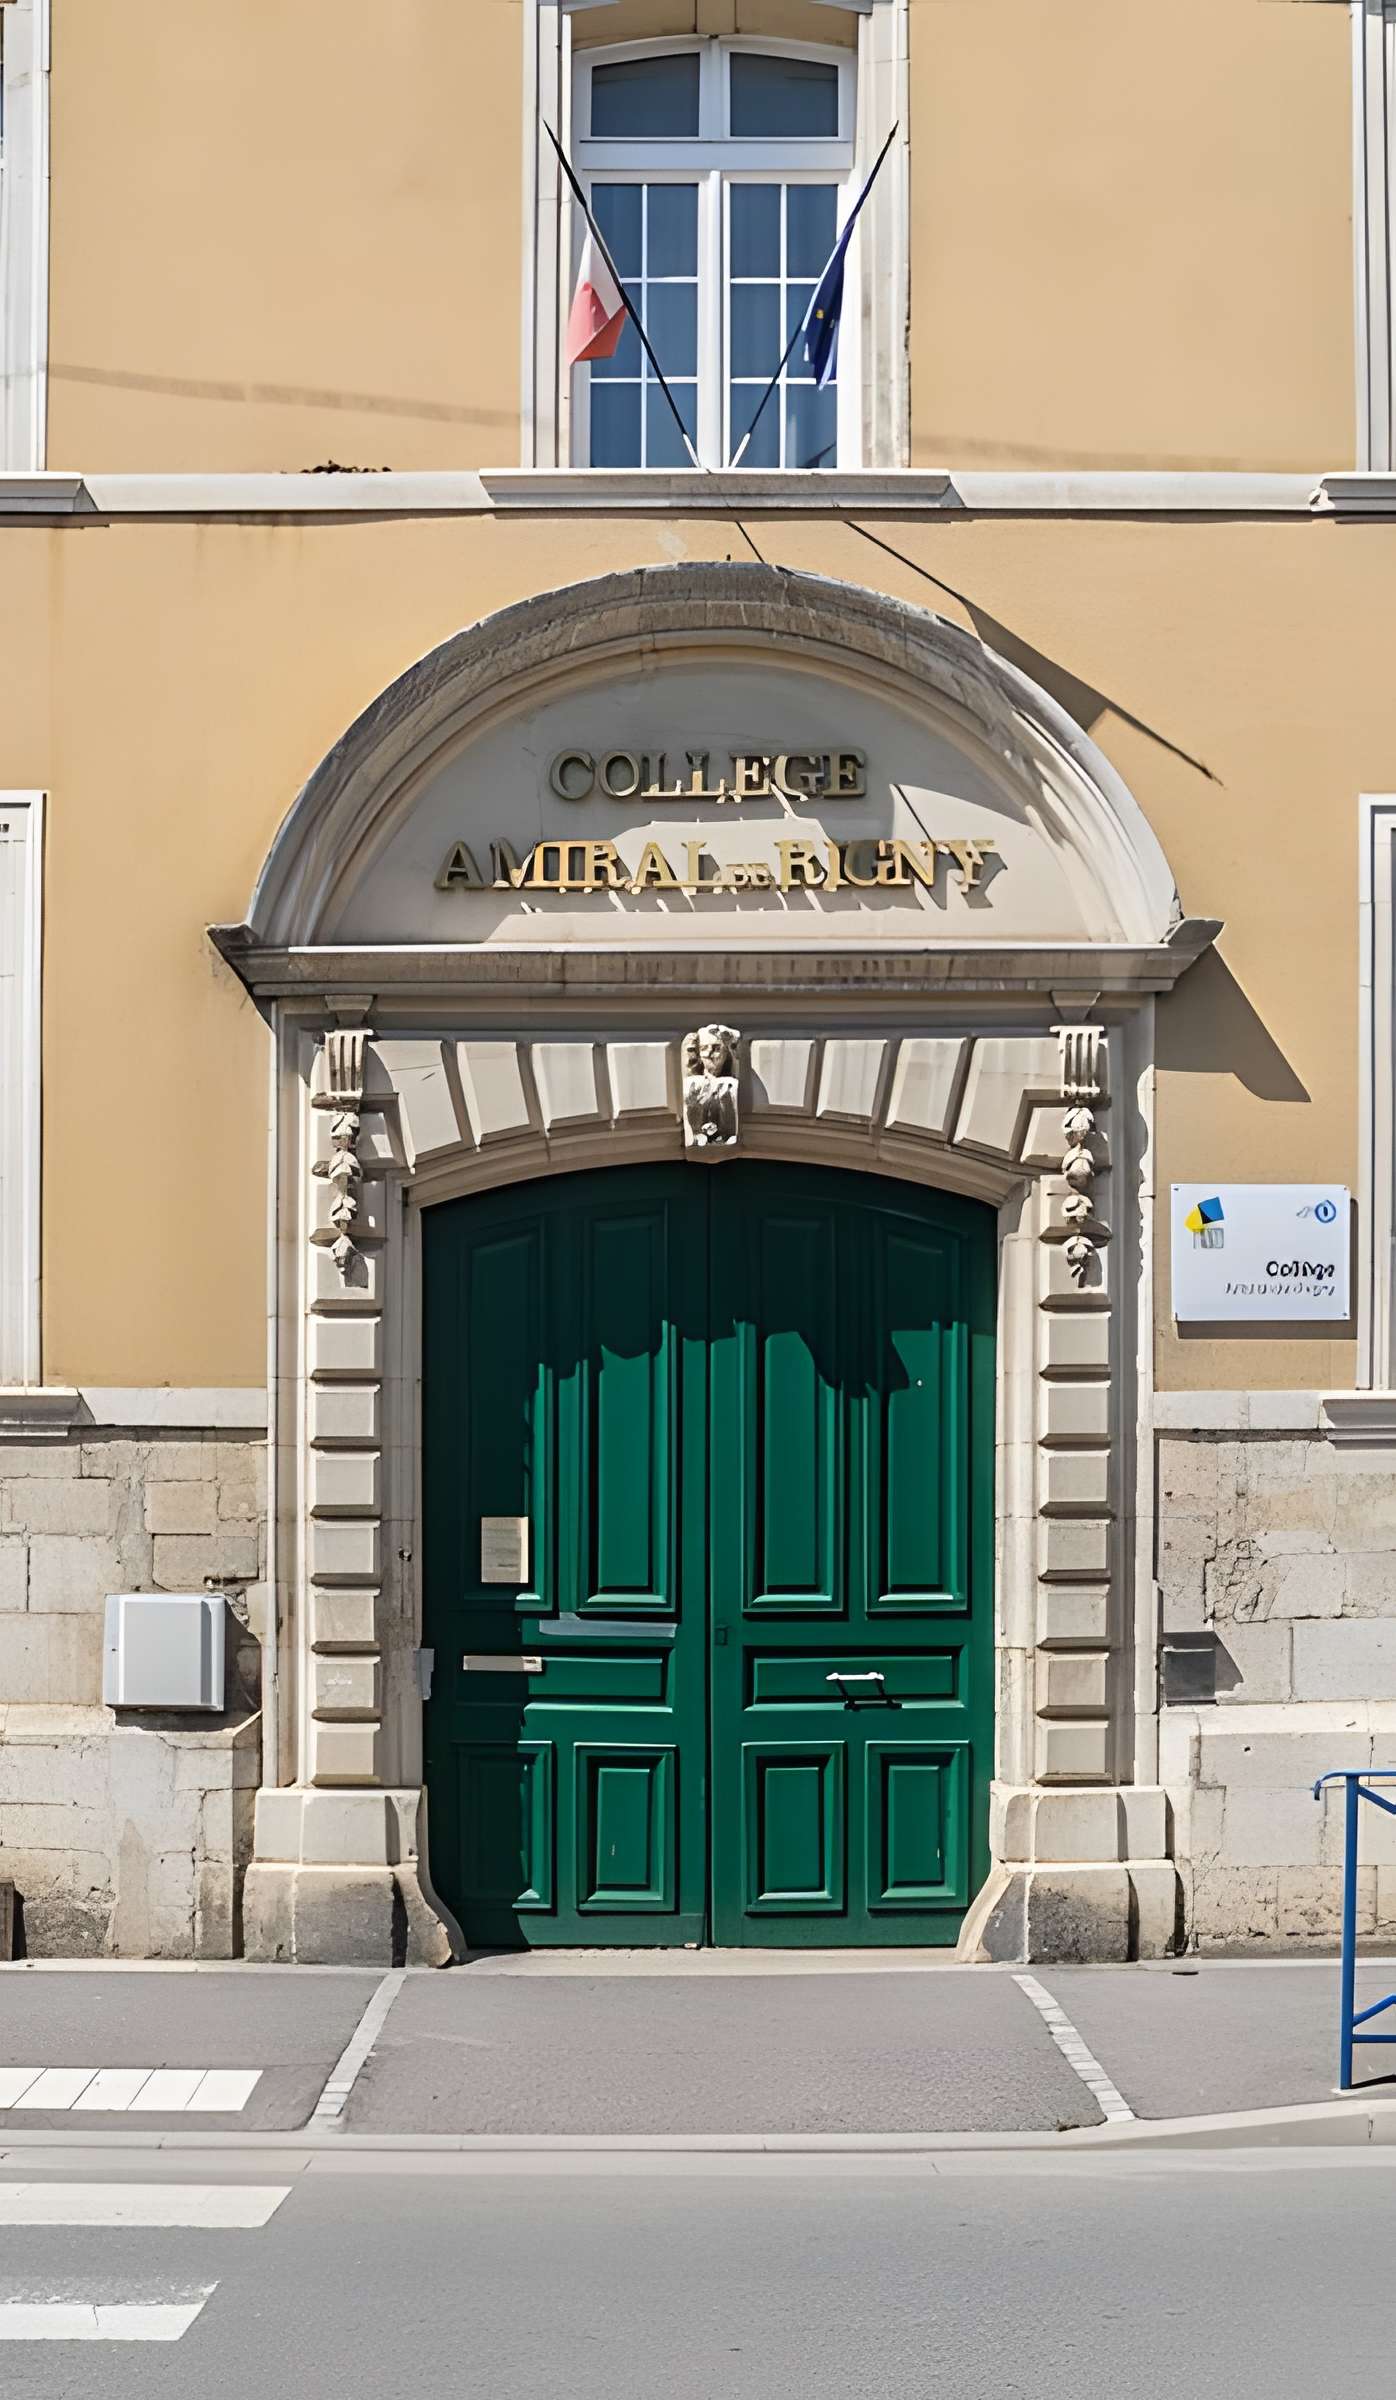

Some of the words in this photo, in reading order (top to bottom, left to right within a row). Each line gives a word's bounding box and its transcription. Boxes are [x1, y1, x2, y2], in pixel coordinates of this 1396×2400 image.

[550, 750, 866, 801] COLLEGE
[434, 838, 722, 890] AMIRAL
[774, 839, 995, 893] RIGNY
